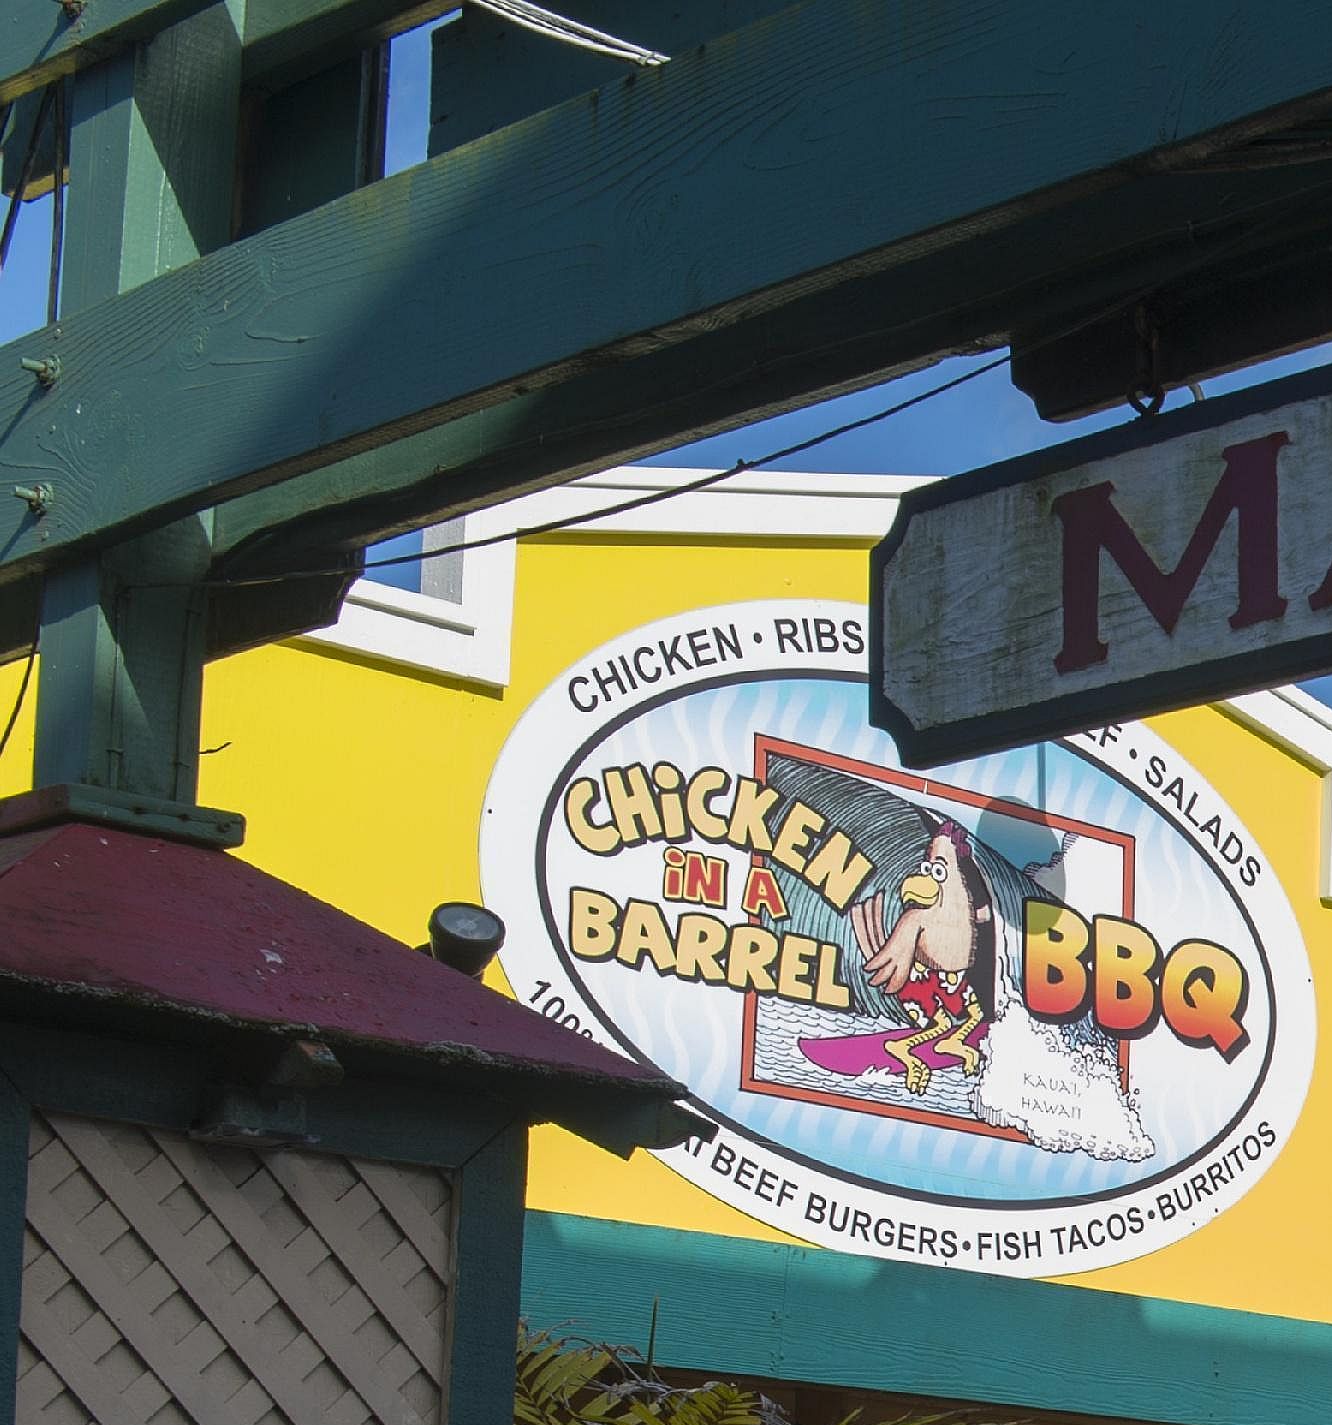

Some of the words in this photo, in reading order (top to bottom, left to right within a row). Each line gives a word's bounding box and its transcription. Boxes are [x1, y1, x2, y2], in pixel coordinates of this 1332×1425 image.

[567, 623, 743, 713] CHICKEN
[777, 616, 864, 656] RIBS
[1144, 755, 1262, 887] SALADS
[567, 889, 852, 1010] BARREL
[742, 866, 789, 921] A
[1022, 897, 1252, 1056] BBQ
[710, 1141, 796, 1209] BEEF
[803, 1193, 958, 1260] BURGERS
[976, 1225, 1042, 1261] FISH
[1050, 1208, 1146, 1258] TACOS
[1155, 1121, 1278, 1222] BURRITOS
